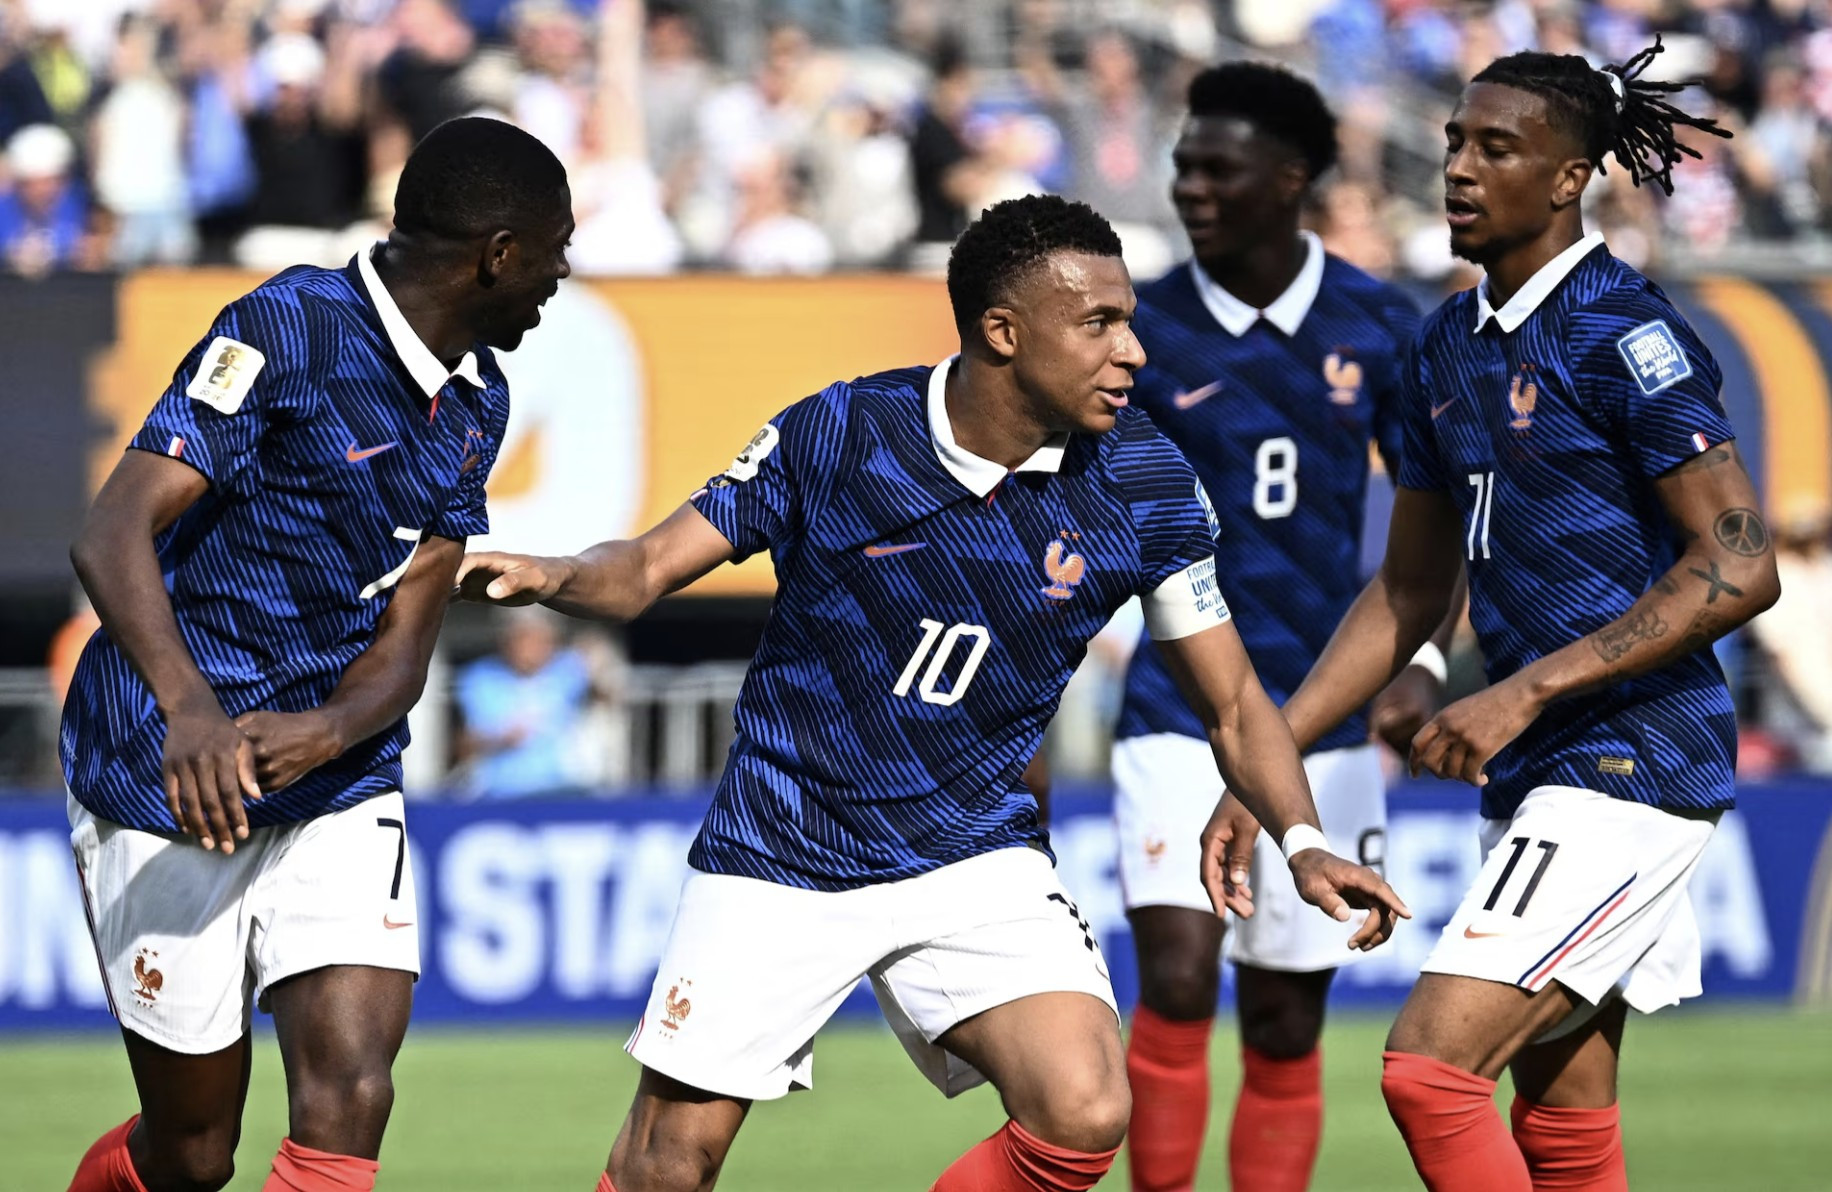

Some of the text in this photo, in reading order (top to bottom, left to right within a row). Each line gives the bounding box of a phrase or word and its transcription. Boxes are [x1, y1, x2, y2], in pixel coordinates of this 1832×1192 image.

[1628, 330, 1665, 353] FOOTBALL
[1633, 340, 1672, 366] UNITES
[1639, 349, 1679, 378] the World
[1253, 436, 1298, 520] 8
[1467, 471, 1495, 561] 11
[358, 525, 424, 600] 7
[1193, 596, 1213, 613] the
[892, 617, 991, 707] 10
[376, 817, 405, 900] 7
[1482, 836, 1560, 918] 11
[437, 820, 703, 1003] STA
